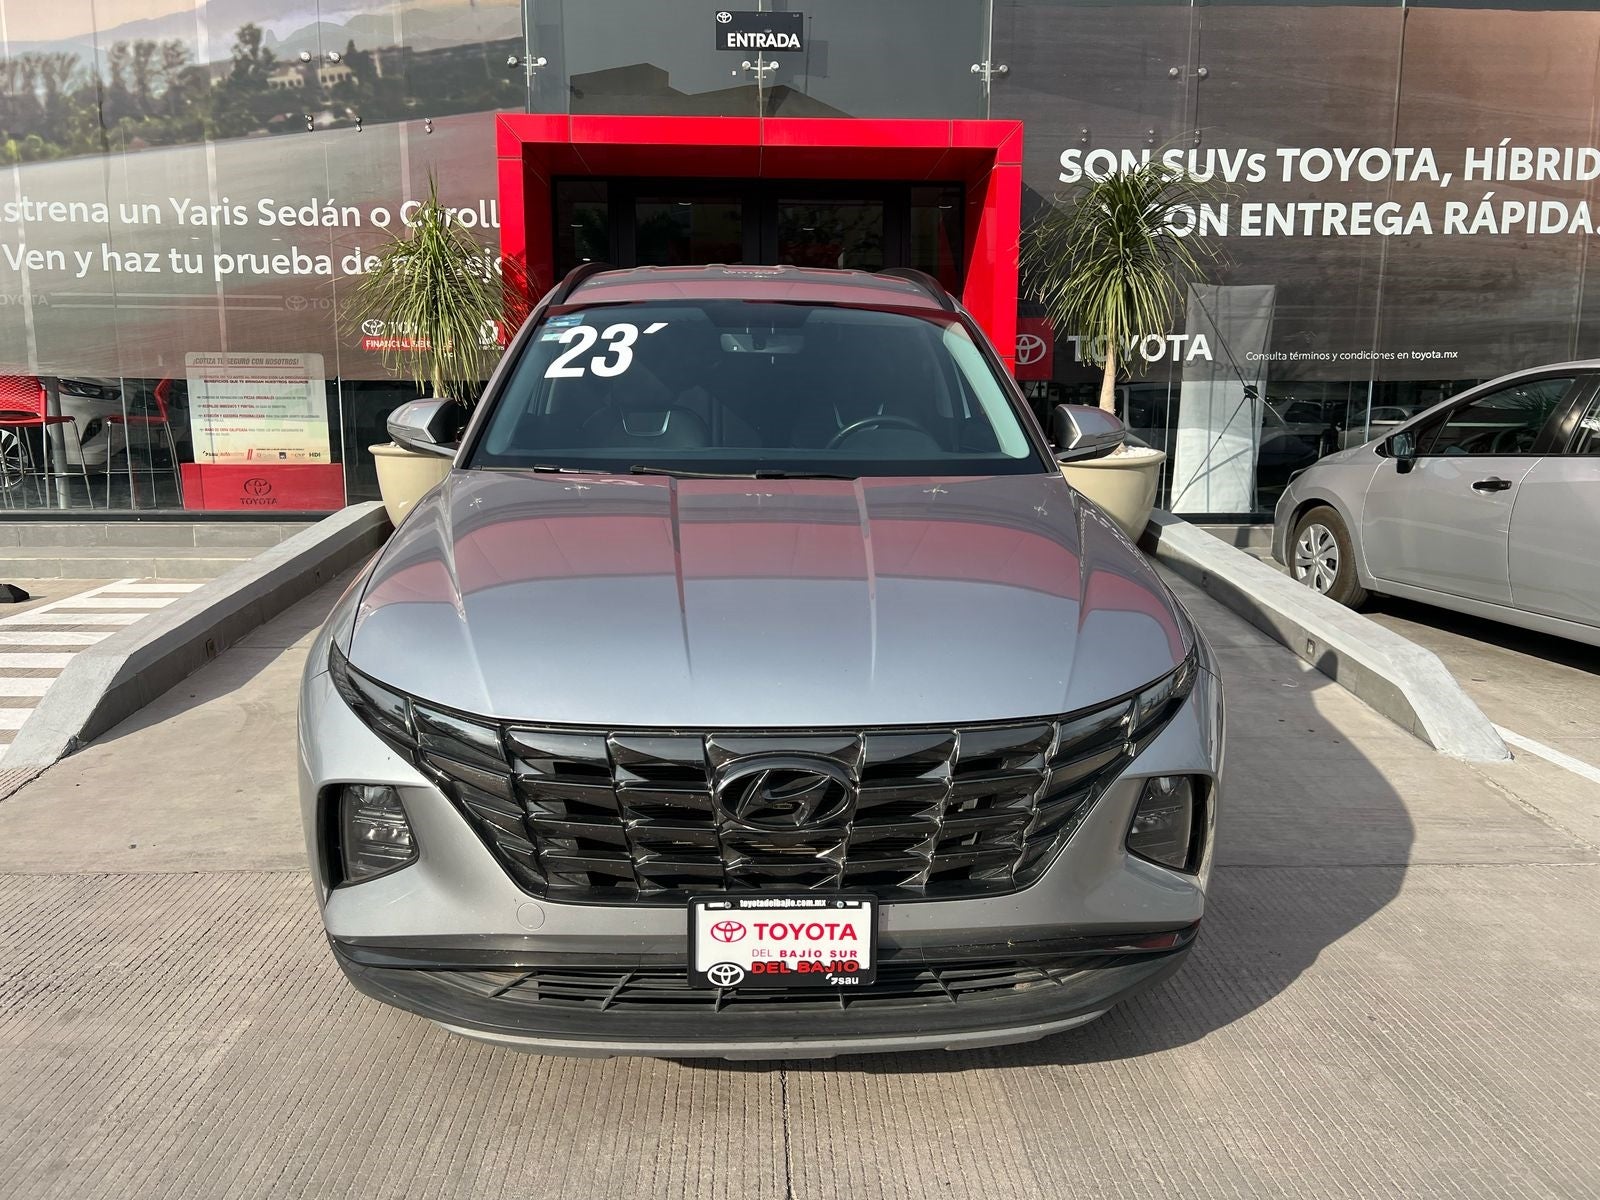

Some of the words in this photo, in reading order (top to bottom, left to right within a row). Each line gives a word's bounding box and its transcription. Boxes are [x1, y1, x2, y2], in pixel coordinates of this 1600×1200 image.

[727, 32, 800, 48] ENTRADA
[1058, 148, 1150, 184] SON
[1160, 148, 1266, 184] SUVs
[1277, 147, 1452, 188] TOYOTA,
[1464, 137, 1600, 181] HÍBRID
[0, 196, 109, 223] strena
[119, 203, 161, 225] un
[168, 197, 248, 226] Yaris
[257, 198, 361, 227] Sedán
[370, 207, 391, 228] o
[400, 199, 500, 229] Croll
[1240, 202, 1433, 237] ENTREGA
[1, 243, 66, 271] Ven
[73, 250, 93, 279] y
[101, 243, 161, 273] haz
[168, 248, 204, 274] tu
[213, 246, 332, 282] prueba
[341, 247, 382, 275] de
[251, 357, 265, 366] CON
[1246, 351, 1287, 361] Consulta
[1289, 350, 1330, 361] términos
[1331, 353, 1338, 362] y
[1339, 350, 1394, 360] condiciones
[1397, 352, 1409, 360] en
[1411, 350, 1458, 361] toyota.mx
[239, 497, 279, 505] TOYOTA
[739, 899, 826, 909] toyotadelbajio.com.mx
[753, 922, 857, 941] TOYOTA
[752, 948, 773, 957] DEL
[779, 948, 822, 958] BAJÍO
[830, 950, 858, 958] SUR
[751, 961, 791, 974] DEL
[797, 960, 860, 974] BAJIO
